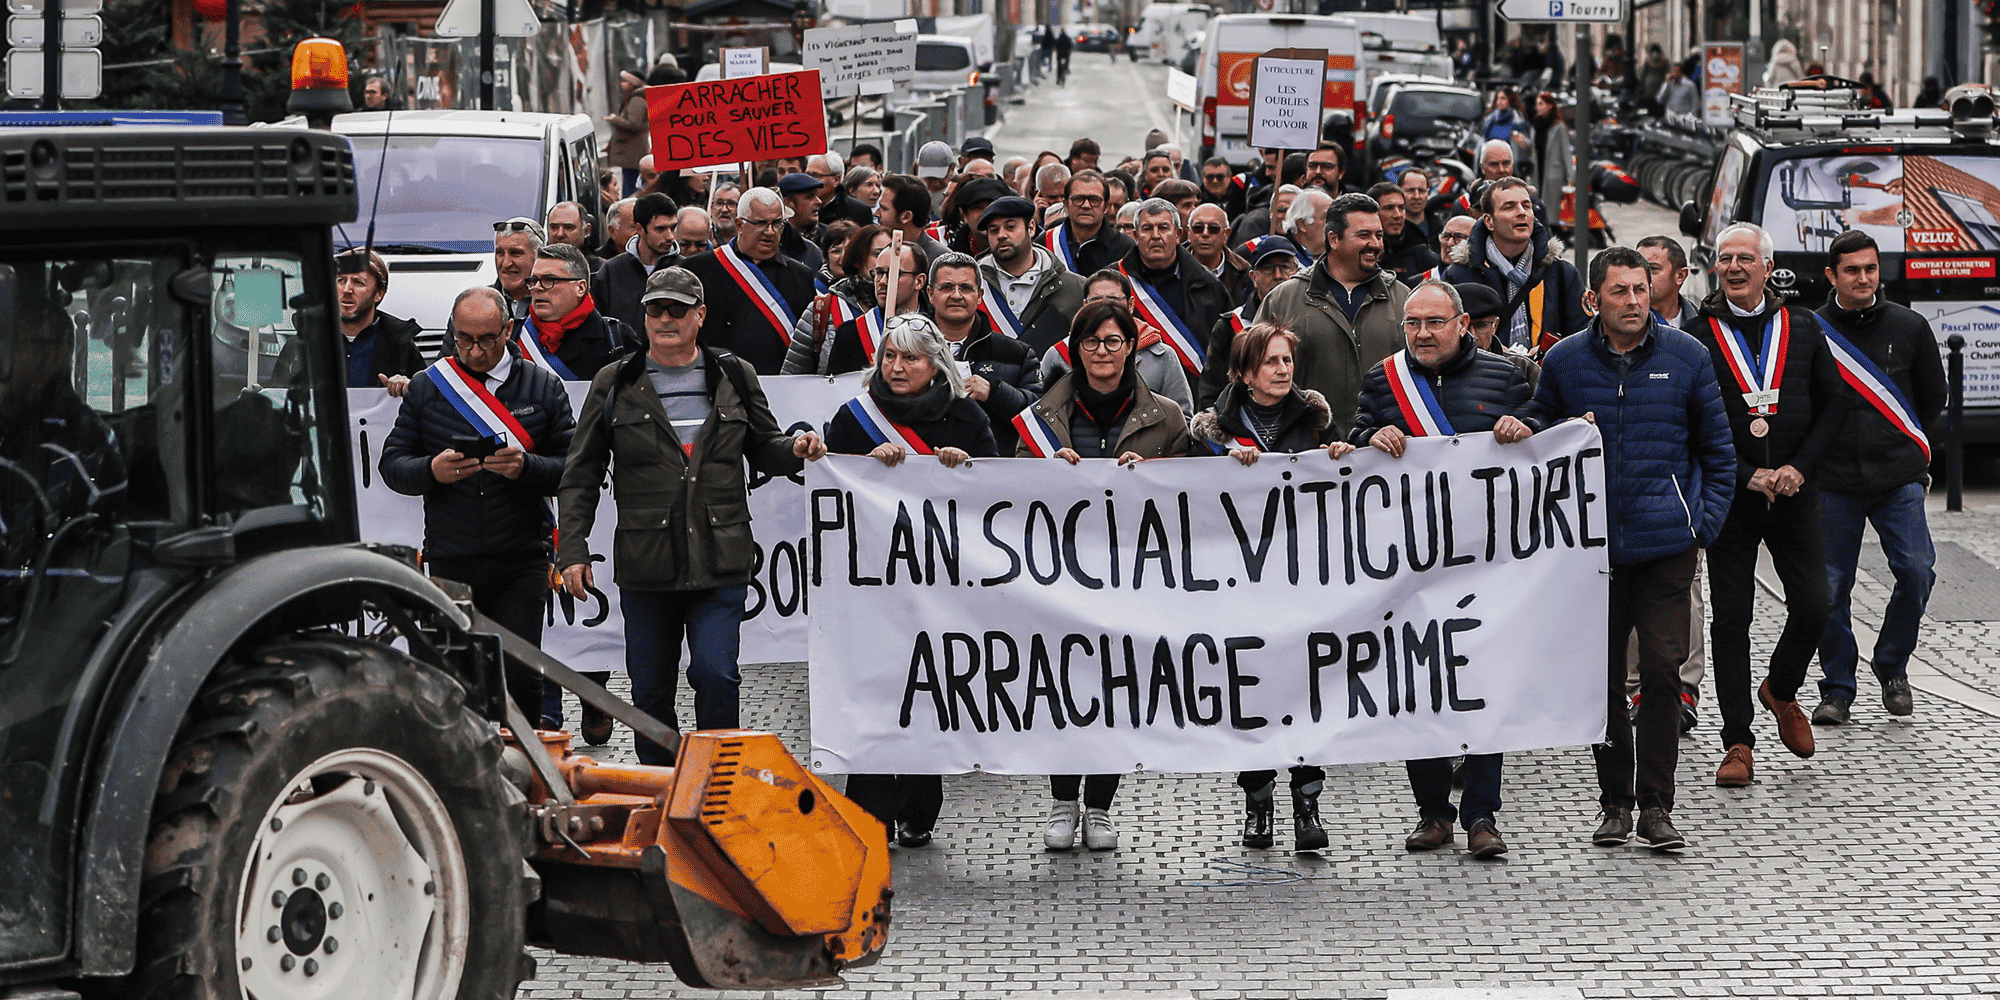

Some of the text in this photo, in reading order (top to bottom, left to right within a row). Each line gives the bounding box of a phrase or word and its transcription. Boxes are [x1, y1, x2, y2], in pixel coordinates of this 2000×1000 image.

[1570, 3, 1615, 17] Tourny
[807, 42, 820, 51] LES
[836, 70, 871, 81] LARMES
[1264, 66, 1316, 75] VITICULTURE
[677, 75, 802, 110] ARRACHER
[1277, 85, 1297, 94] LES
[1264, 95, 1309, 106] OUBLIES
[669, 101, 798, 128] POUR SAUVER
[1278, 108, 1294, 117] DU
[1262, 119, 1308, 129] POUVOIR
[667, 130, 734, 161] DES
[1912, 232, 1955, 244] VELUX
[1910, 260, 1991, 269] CONTRAT D'ENTRETIEN
[1930, 268, 1972, 276] DE TOITURE
[1941, 323, 1971, 331] Pascal
